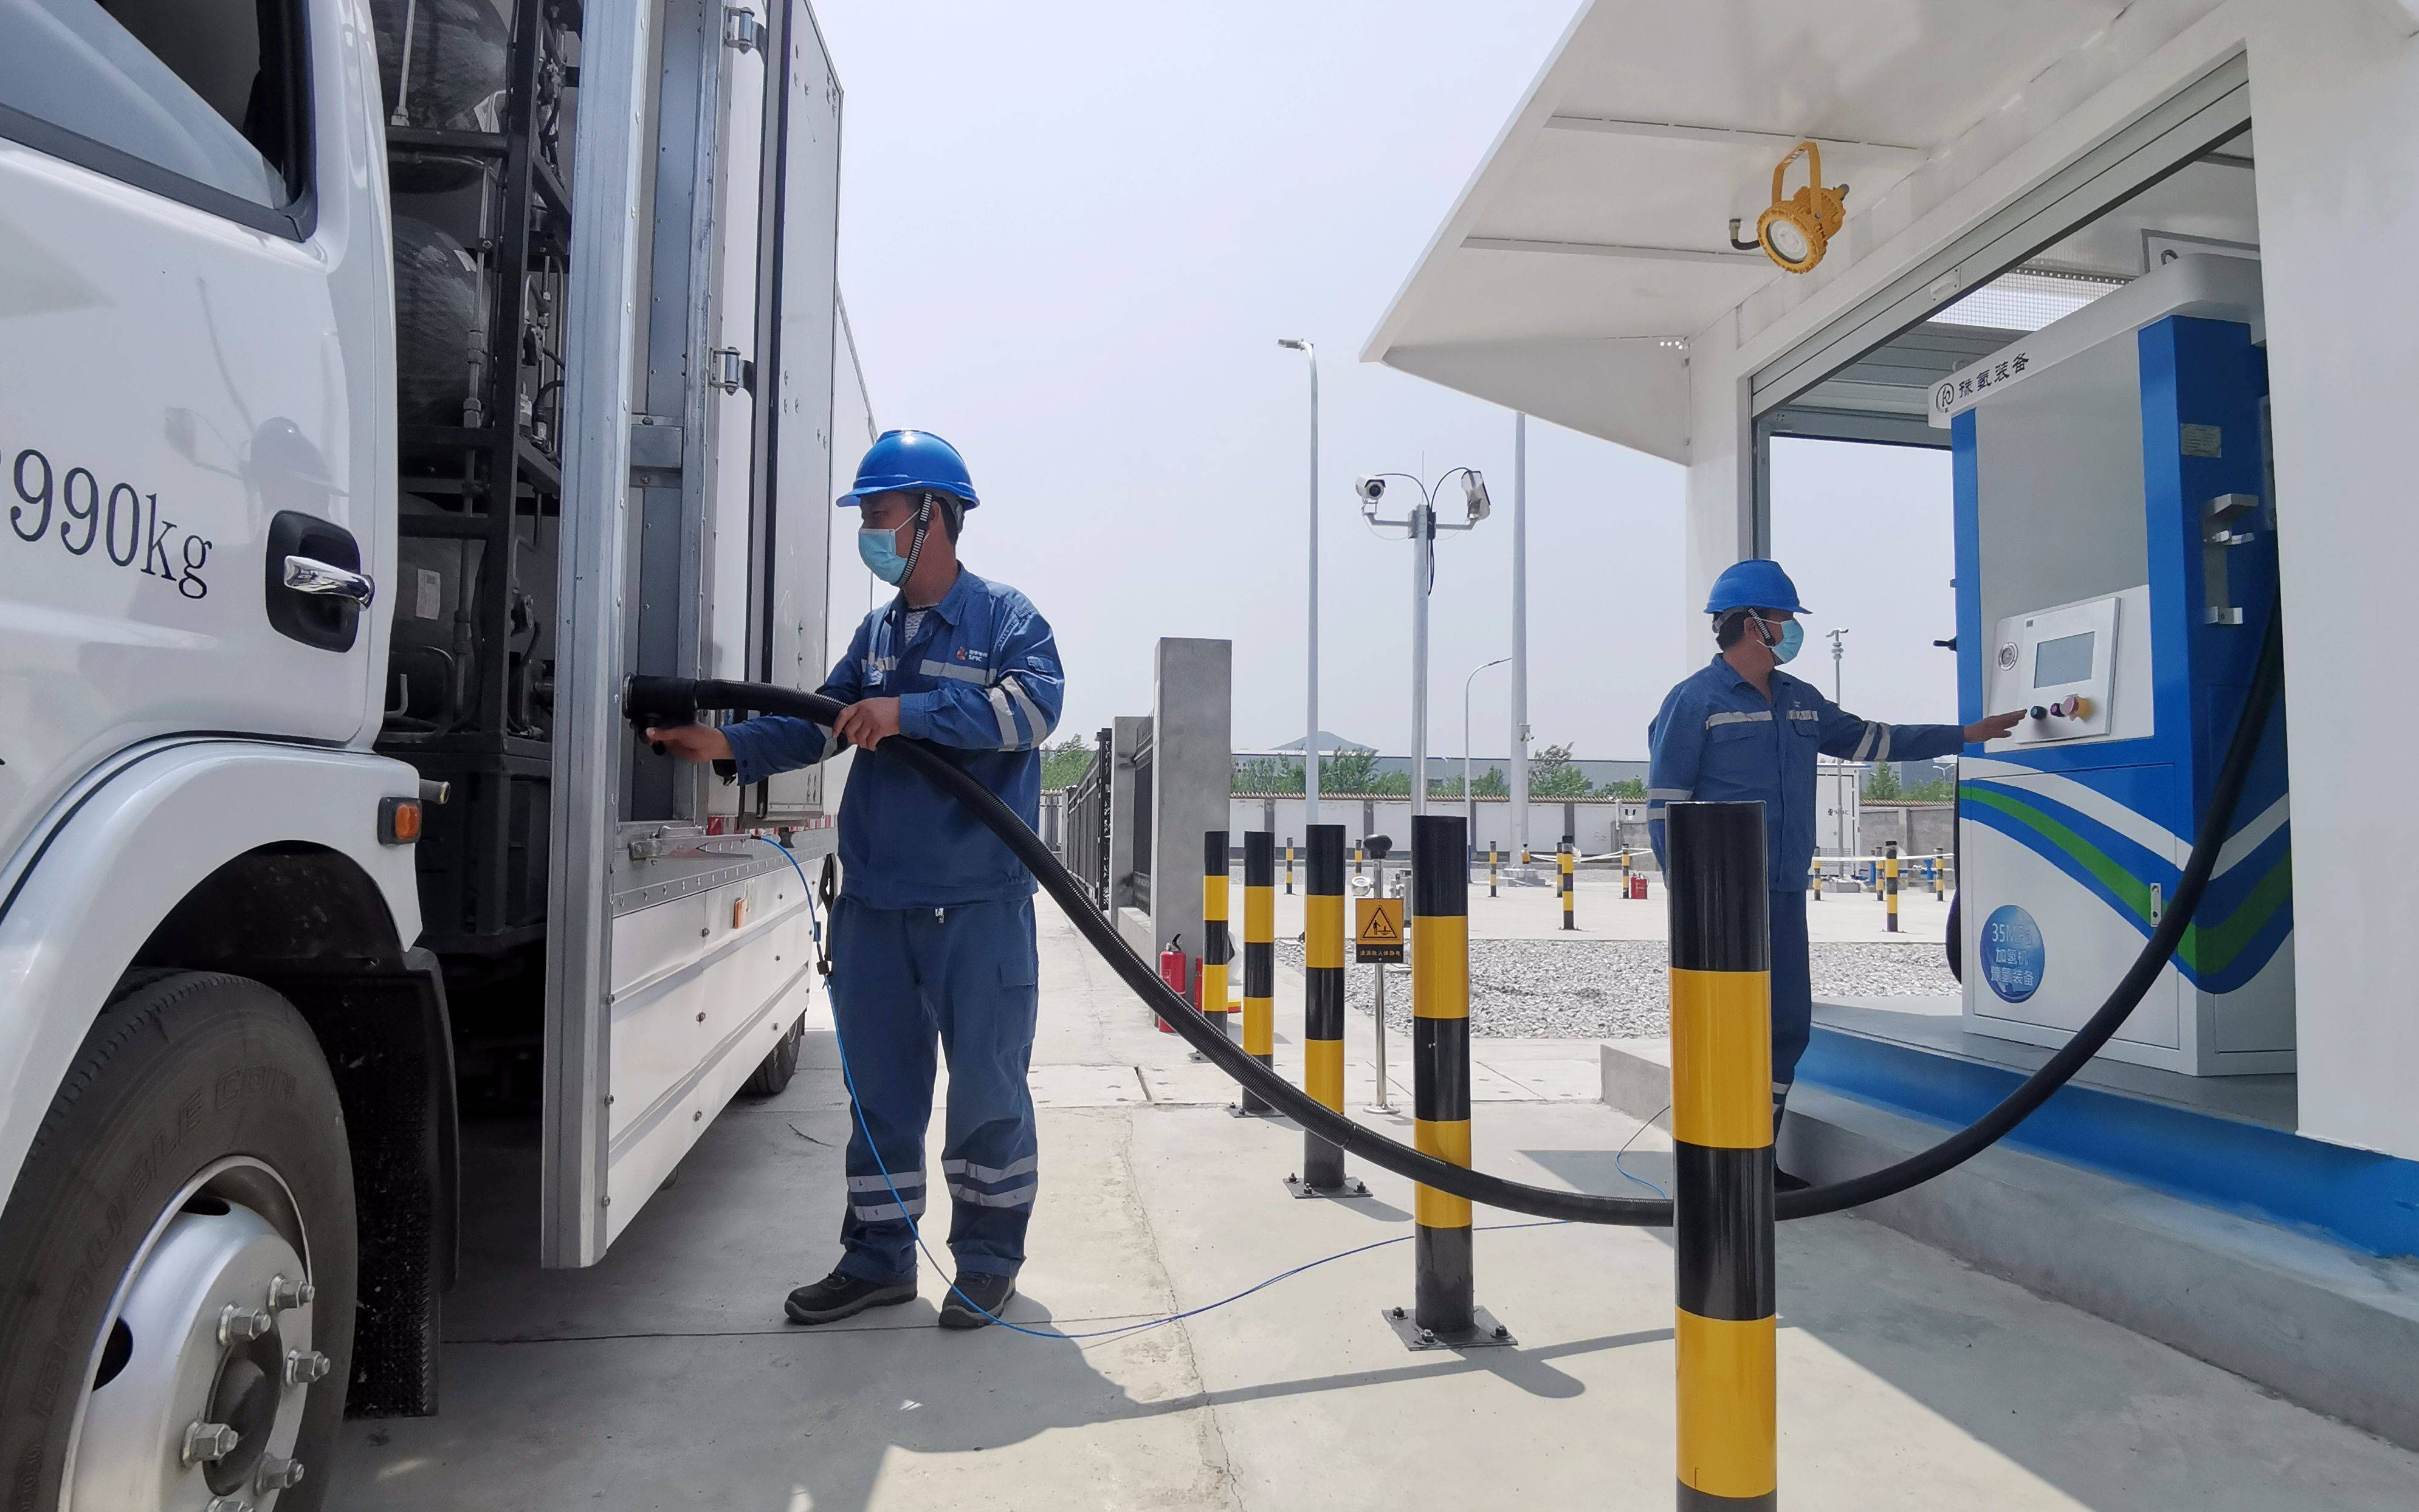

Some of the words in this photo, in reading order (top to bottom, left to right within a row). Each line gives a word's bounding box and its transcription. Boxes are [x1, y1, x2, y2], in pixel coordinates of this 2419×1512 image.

[1958, 352, 2029, 398] 豫氢装备
[0, 447, 212, 599] 990kg
